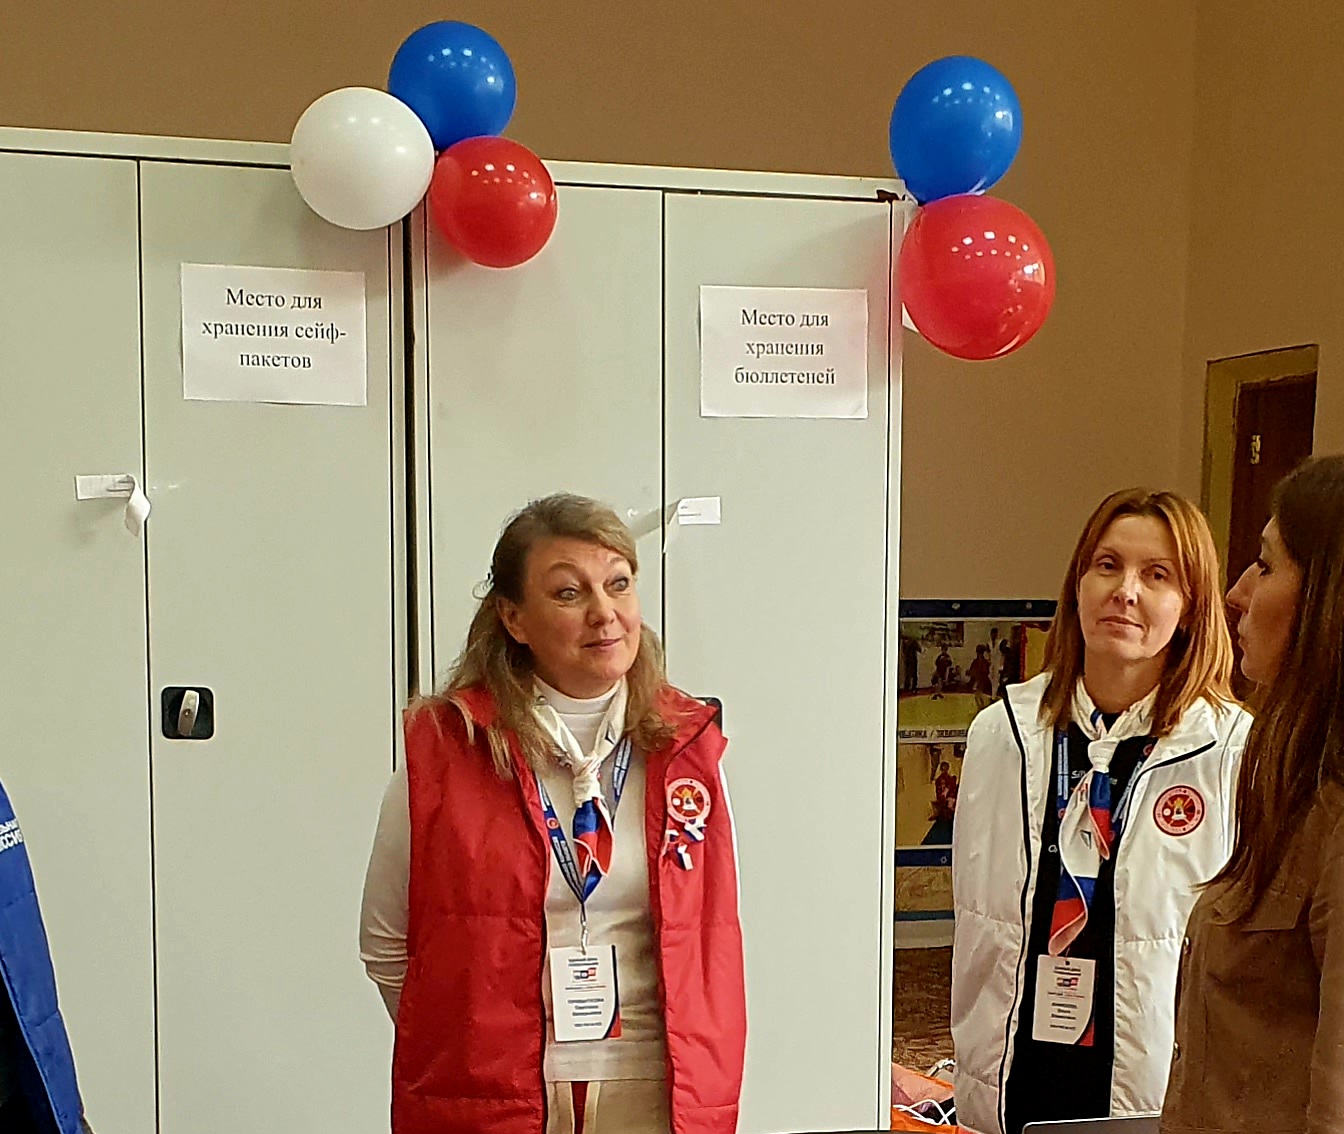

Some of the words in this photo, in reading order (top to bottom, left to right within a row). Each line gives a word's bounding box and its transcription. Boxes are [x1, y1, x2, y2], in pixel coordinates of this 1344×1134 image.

[225, 288, 285, 308] Место
[290, 296, 323, 310] для
[741, 308, 796, 326] Место
[799, 314, 830, 328] для
[202, 322, 289, 340] хранения
[295, 322, 347, 344] сейф-
[745, 342, 824, 359] хранения
[239, 353, 312, 369] пакетов
[734, 366, 836, 385] бюллетеней
